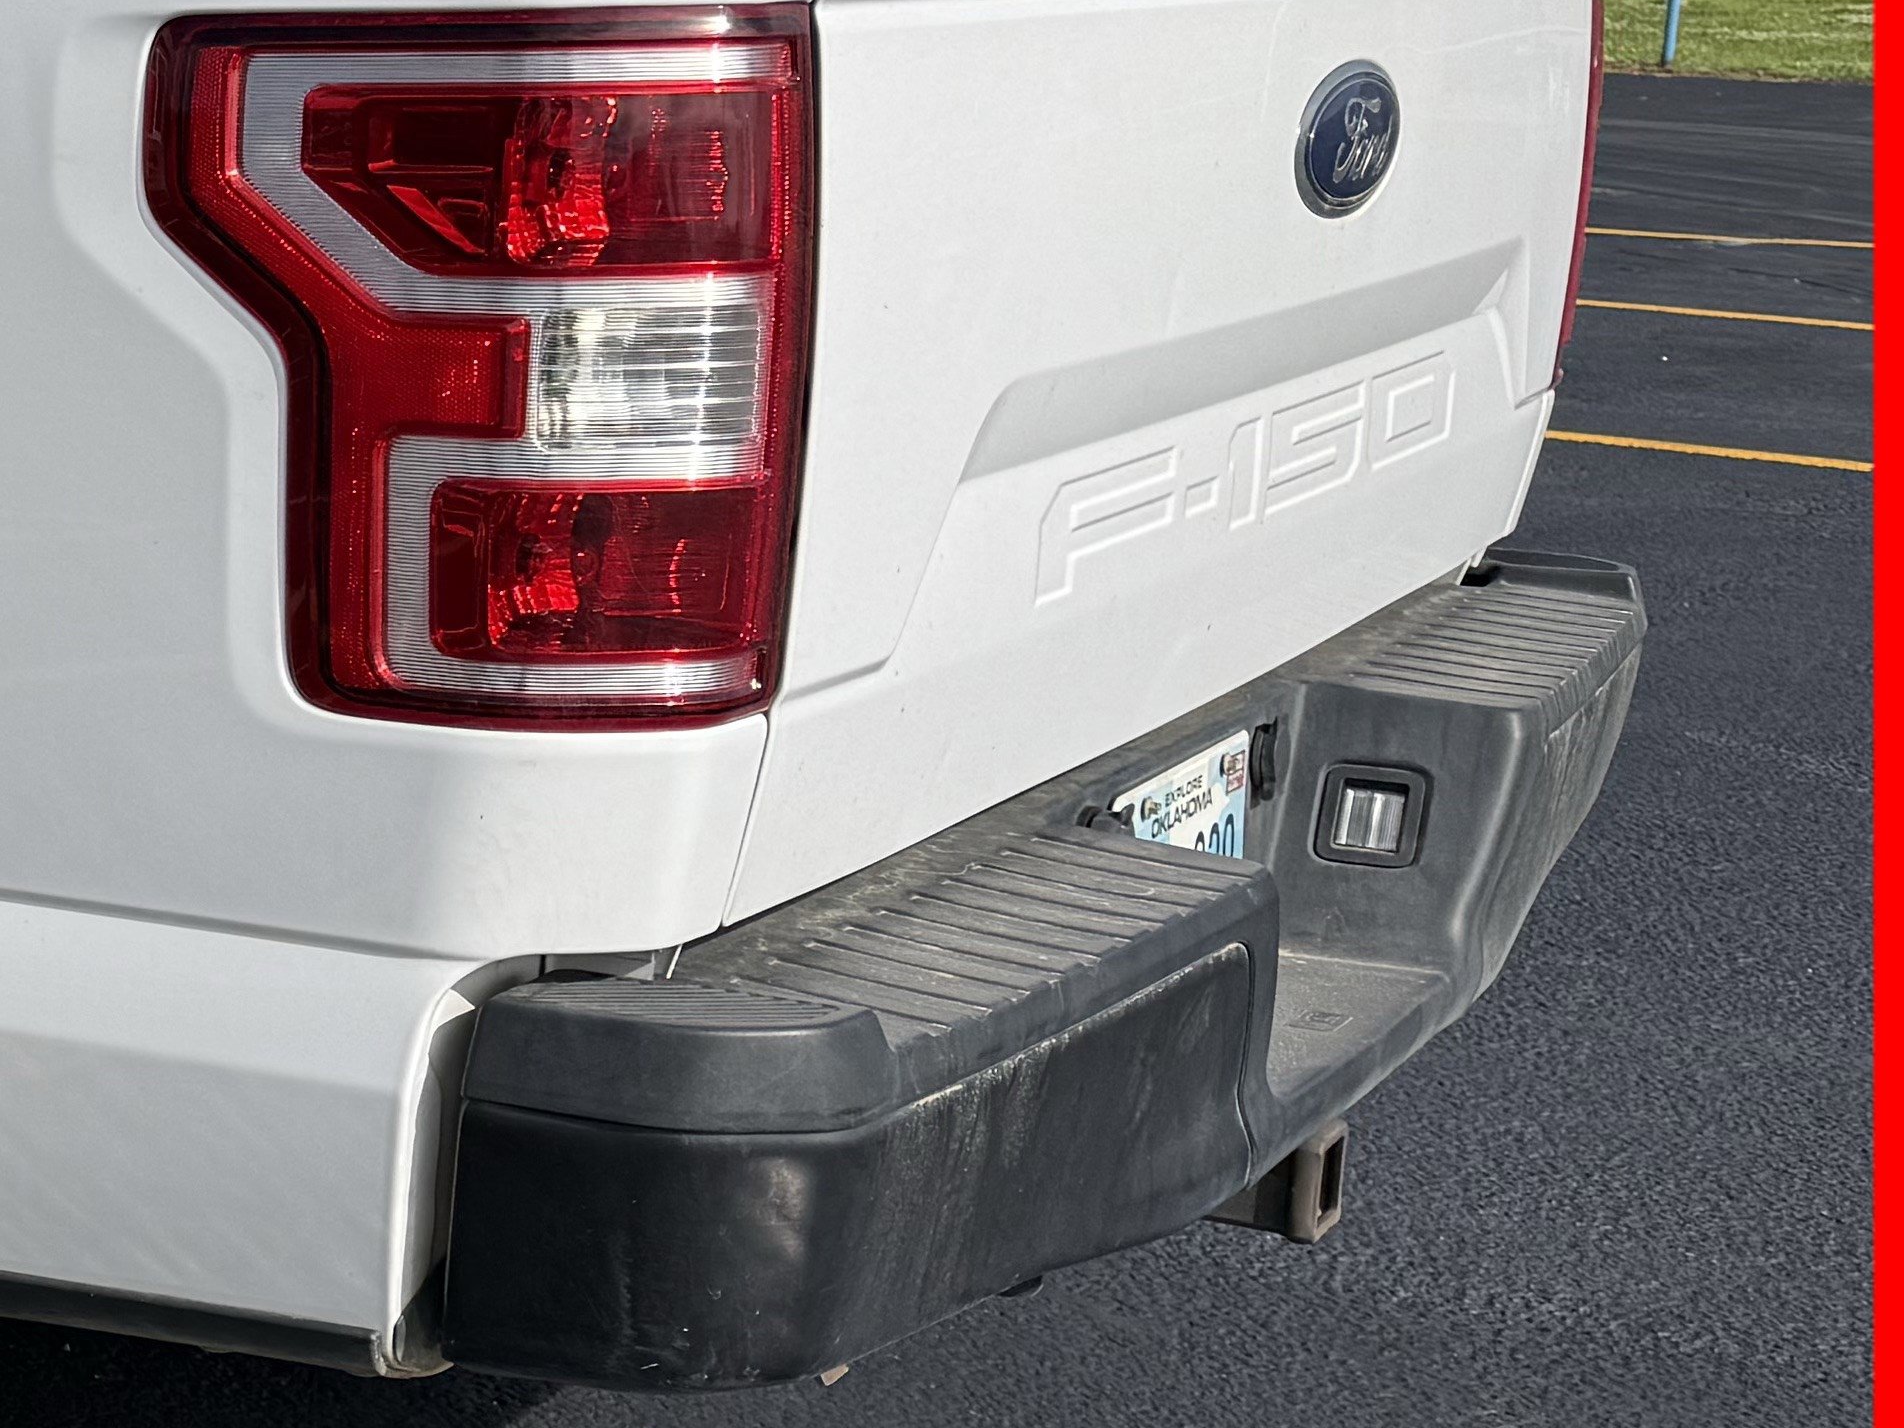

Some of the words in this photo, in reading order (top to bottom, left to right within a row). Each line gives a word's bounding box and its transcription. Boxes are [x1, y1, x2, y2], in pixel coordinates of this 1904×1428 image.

[1333, 96, 1393, 184] Ford
[1034, 348, 1456, 608] F-150
[1151, 787, 1214, 840] OKLAHOMA
[1164, 774, 1204, 808] EXPLORE
